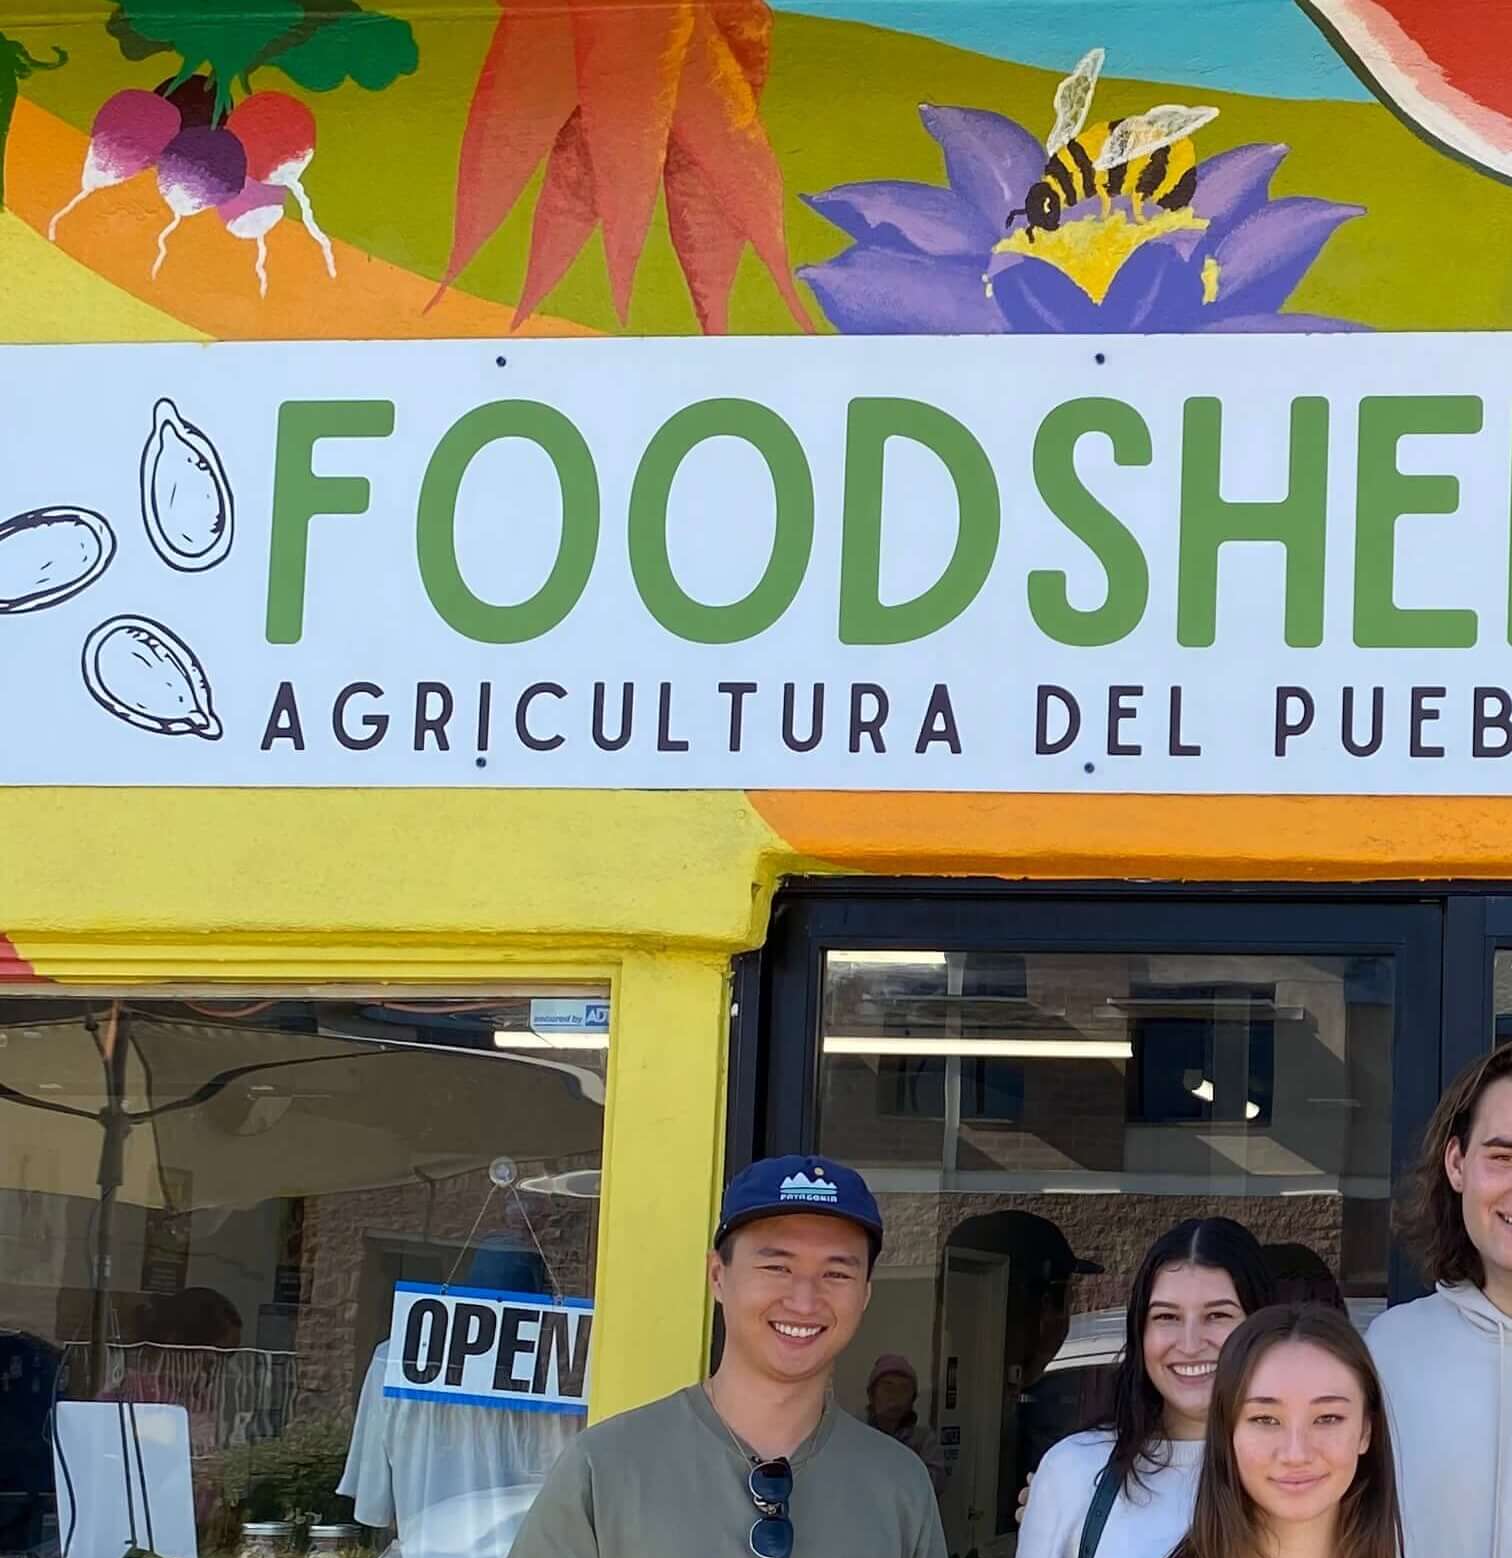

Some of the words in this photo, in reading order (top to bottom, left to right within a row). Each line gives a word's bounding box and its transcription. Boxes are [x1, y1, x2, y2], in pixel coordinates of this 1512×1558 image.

[260, 681, 962, 755] AGRICULTURA
[1034, 684, 1201, 757] DEL
[586, 1007, 609, 1023] AD
[402, 1297, 593, 1398] OPEN
